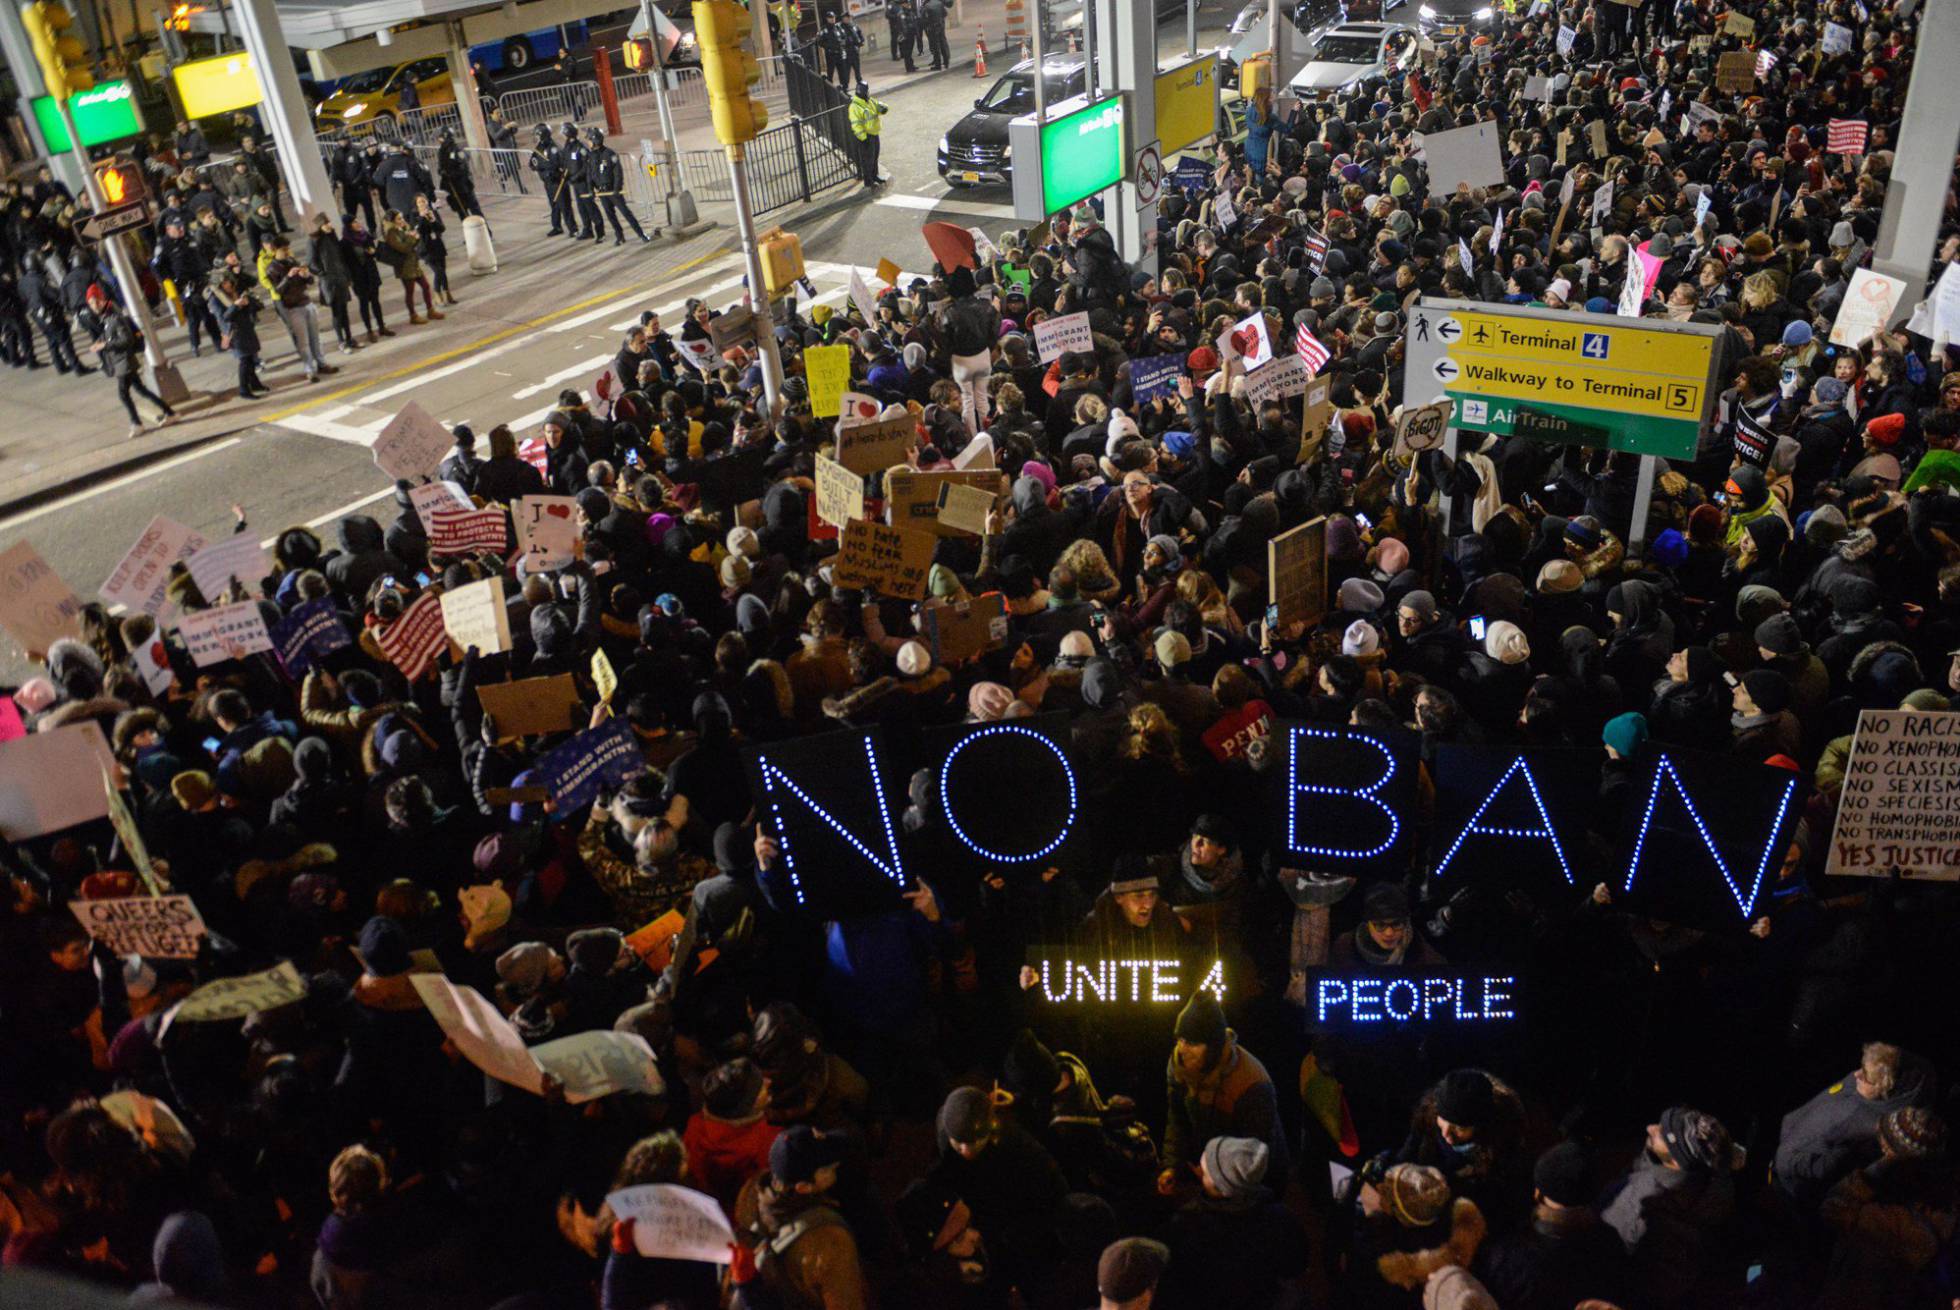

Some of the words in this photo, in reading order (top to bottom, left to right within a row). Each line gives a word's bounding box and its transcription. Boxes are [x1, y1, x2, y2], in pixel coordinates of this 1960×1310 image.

[99, 217, 118, 232] ONE
[121, 210, 139, 224] WAY
[1037, 325, 1089, 345] IMMIGRANT
[1040, 342, 1058, 353] NEW
[1063, 335, 1090, 347] YORK
[1500, 329, 1576, 351] Terminal
[1584, 333, 1607, 358] 4
[1248, 367, 1305, 397] IMMIGRANT
[1276, 376, 1307, 390] YORK
[1466, 364, 1548, 390] Walkway
[1555, 376, 1575, 390] to
[1583, 378, 1662, 401] Terminal
[1673, 387, 1688, 406] 5
[847, 400, 855, 417] I
[1492, 408, 1568, 431] AirTrain
[456, 517, 488, 530] PLEDGE
[456, 525, 496, 538] PROTECT
[189, 617, 261, 643] IMMIGRANT
[1859, 714, 1890, 735] NO
[1221, 714, 1270, 758] PENN
[562, 753, 594, 780] STAND
[594, 734, 623, 755] WITH
[1854, 740, 1879, 755] NO
[1850, 760, 1878, 775] NO
[1884, 760, 1960, 777] CLASSIS
[1846, 778, 1874, 793] NO
[1842, 795, 1869, 810] NO
[759, 724, 1080, 906] NO
[1286, 727, 1798, 920] BAN
[1839, 812, 1864, 825] NO
[1870, 812, 1960, 828] HOMOPHOBI
[1836, 826, 1860, 839] NO
[1837, 843, 1877, 868] YES
[90, 900, 194, 922] QUEERS
[1042, 959, 1181, 1003] UNITE
[1318, 975, 1516, 1023] PEOPLE
